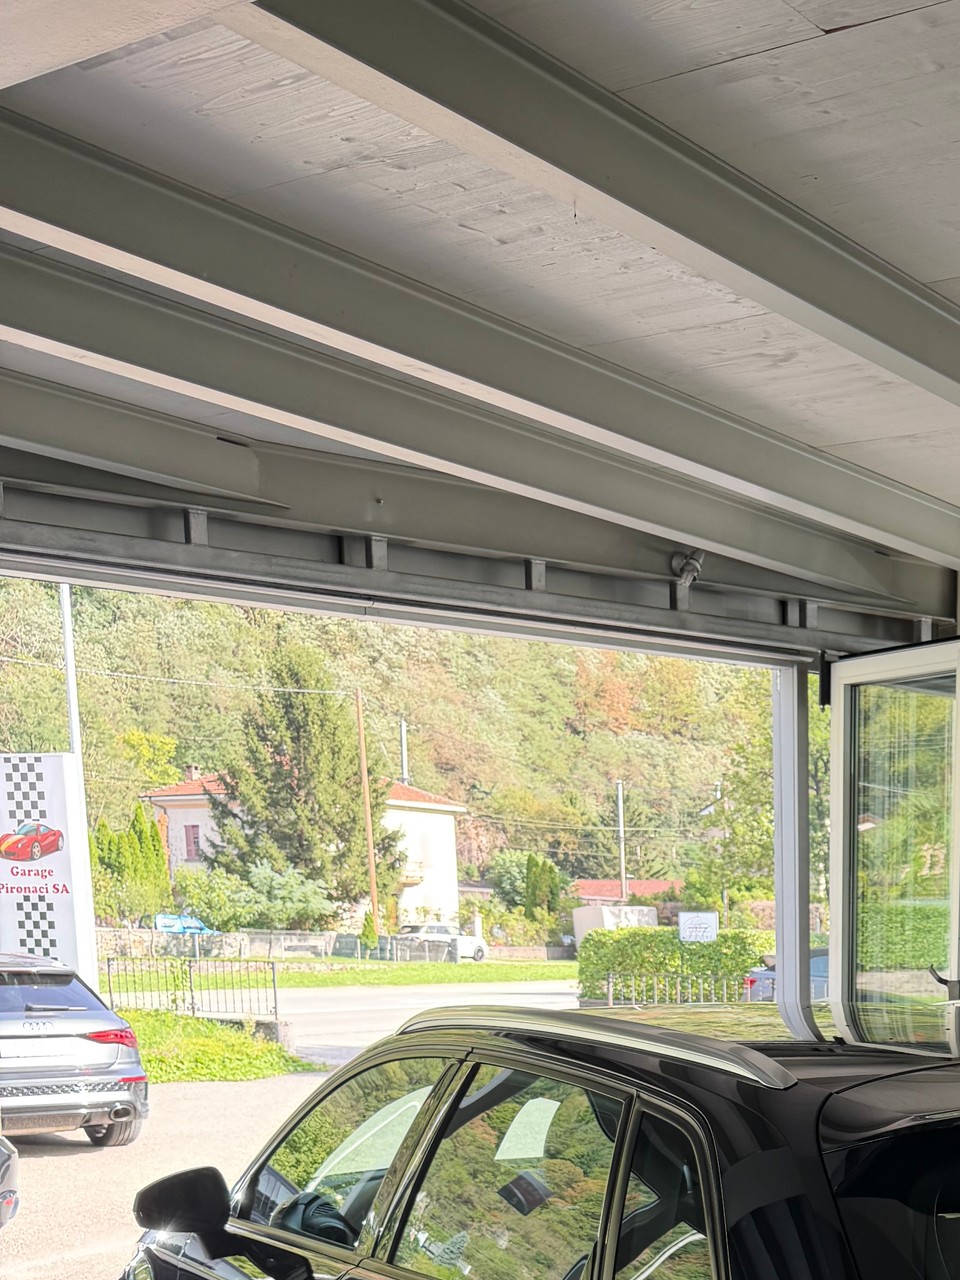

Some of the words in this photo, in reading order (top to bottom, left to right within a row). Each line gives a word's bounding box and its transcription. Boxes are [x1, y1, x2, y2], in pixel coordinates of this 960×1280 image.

[10, 866, 54, 879] Garage
[0, 883, 49, 894] Pironaci
[52, 883, 70, 894] SA
